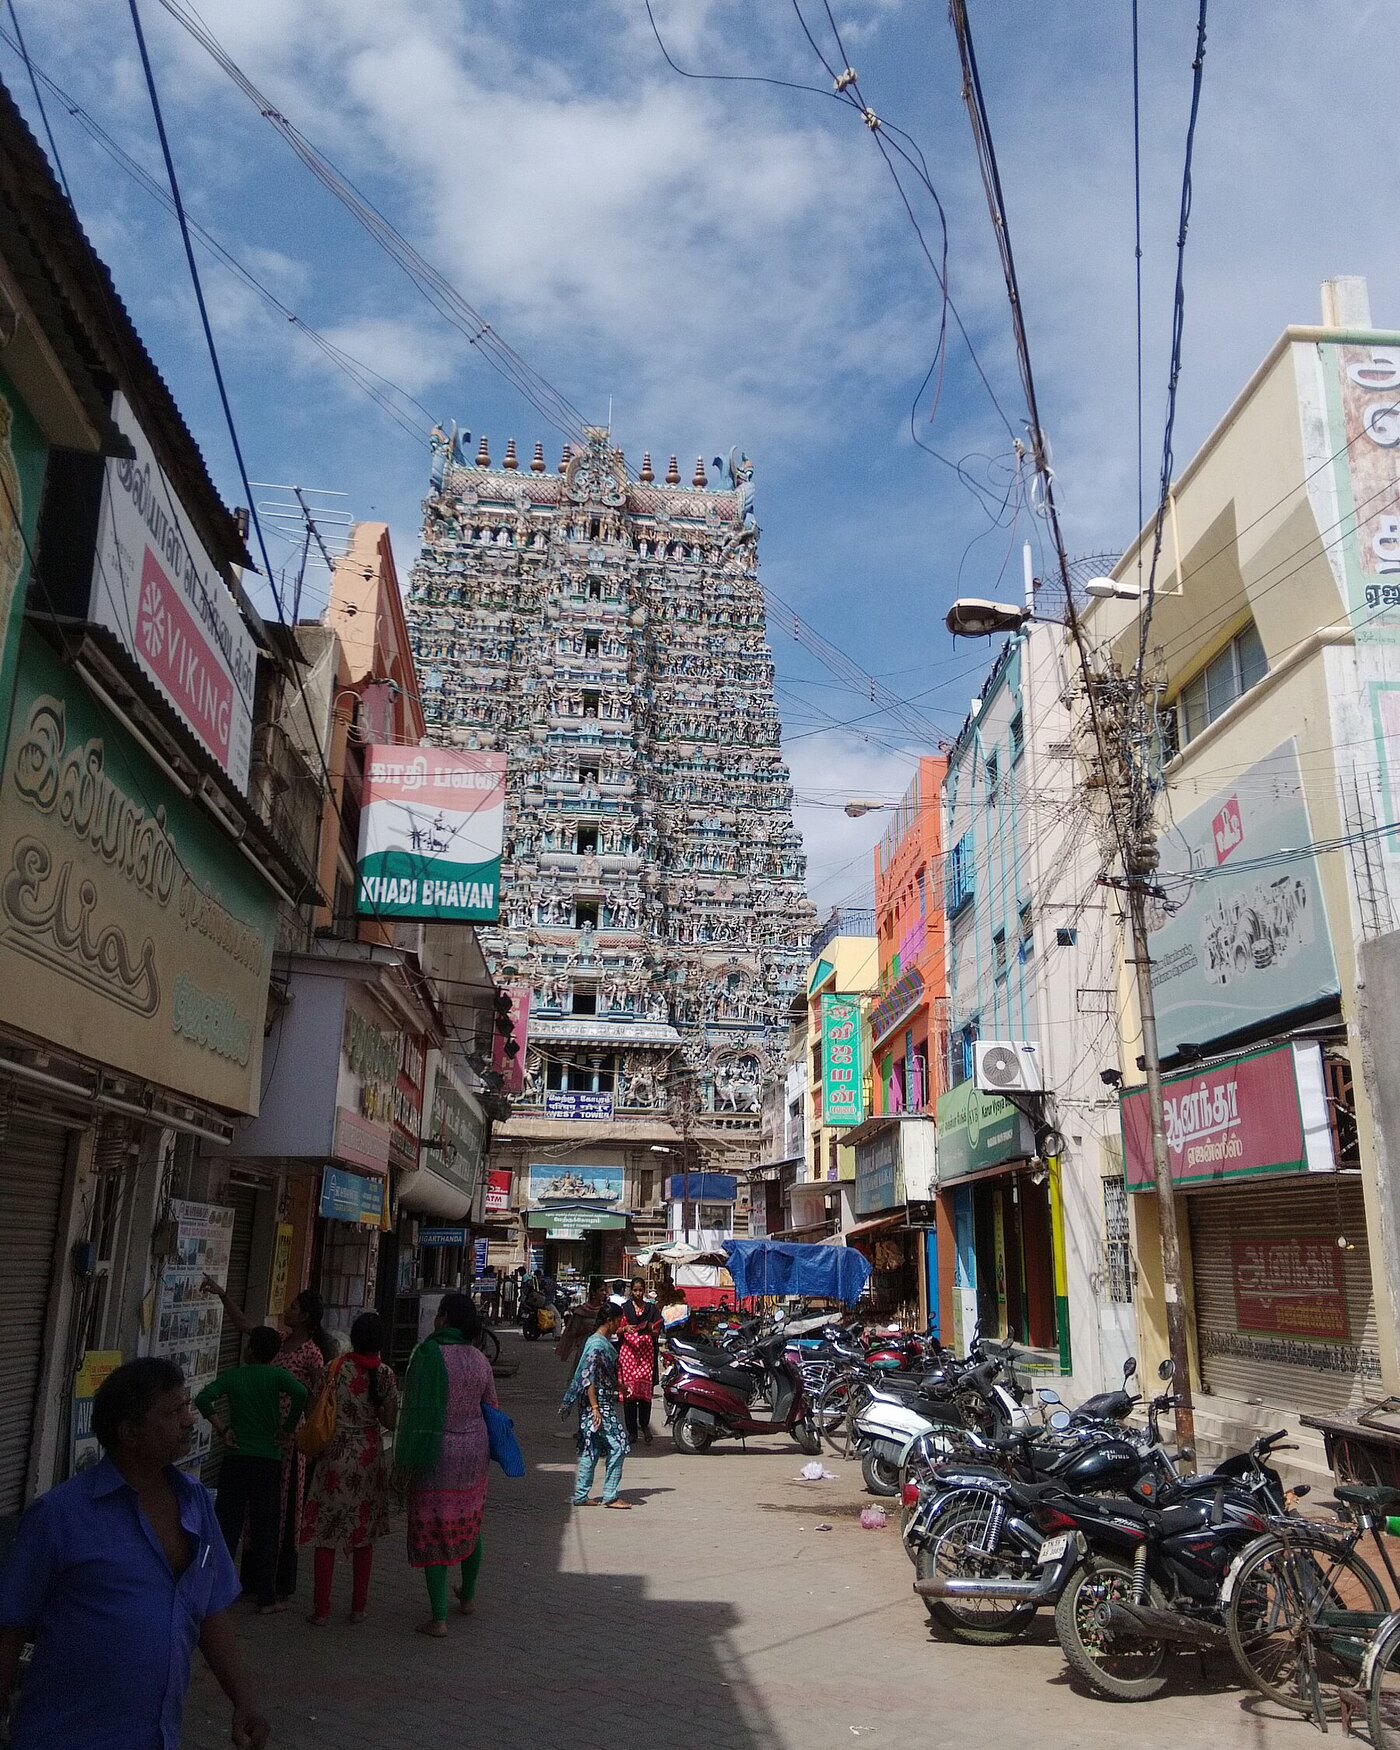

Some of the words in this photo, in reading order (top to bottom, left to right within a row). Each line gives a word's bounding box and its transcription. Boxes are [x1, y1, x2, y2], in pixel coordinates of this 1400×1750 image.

[167, 612, 229, 746] VIKING
[368, 756, 427, 792] காதி
[360, 876, 418, 904] KHADI
[422, 879, 494, 909] BHAVAN
[1, 834, 160, 1018] Elias
[579, 1111, 610, 1119] TOWER
[486, 1194, 502, 1202] ATM
